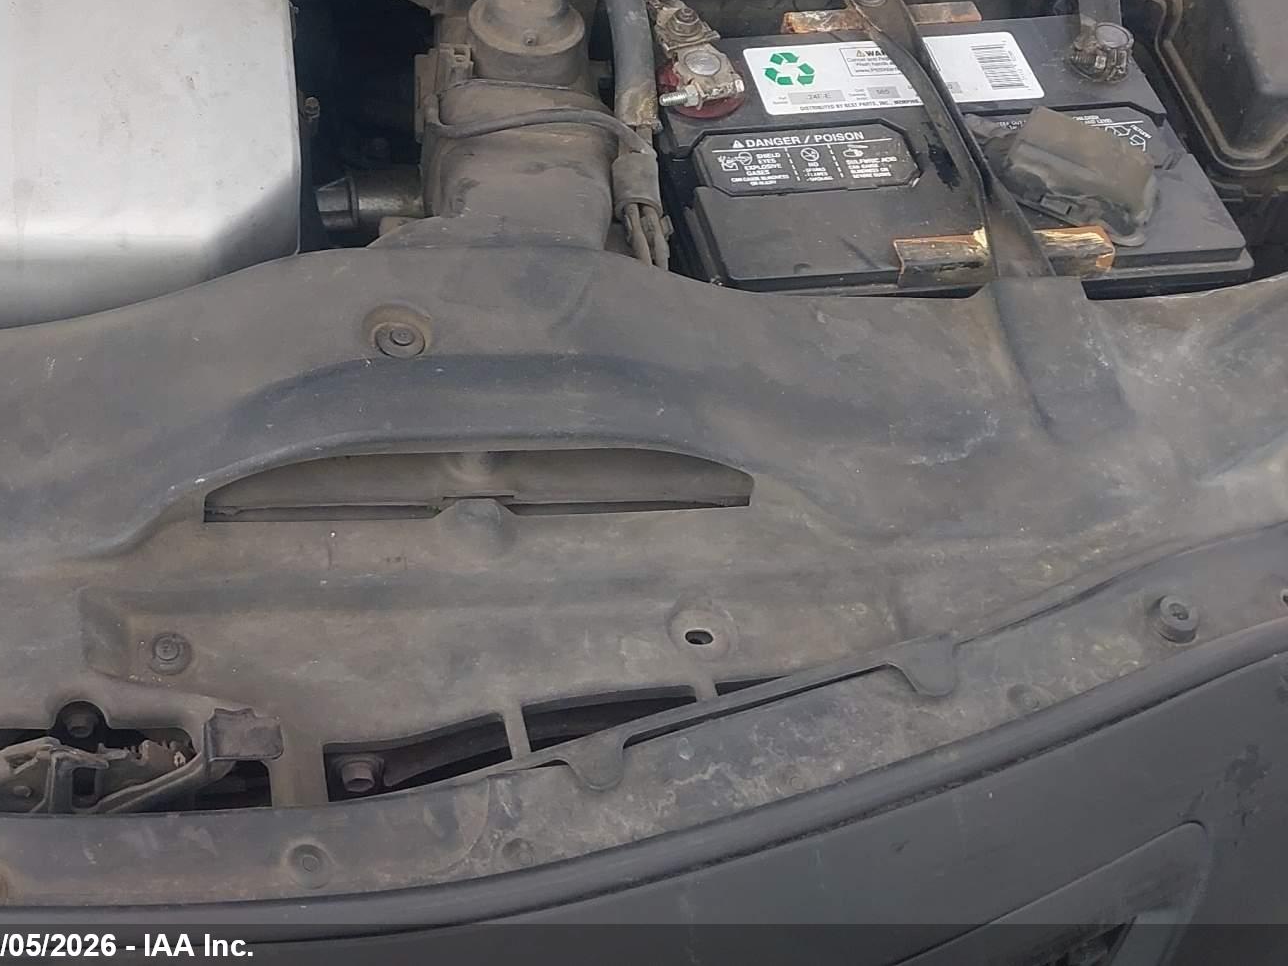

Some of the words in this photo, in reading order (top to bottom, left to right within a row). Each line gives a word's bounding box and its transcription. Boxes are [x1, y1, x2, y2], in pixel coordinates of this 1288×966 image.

[746, 136, 801, 148] DANGER
[804, 135, 810, 143] /
[814, 131, 864, 143] POISON
